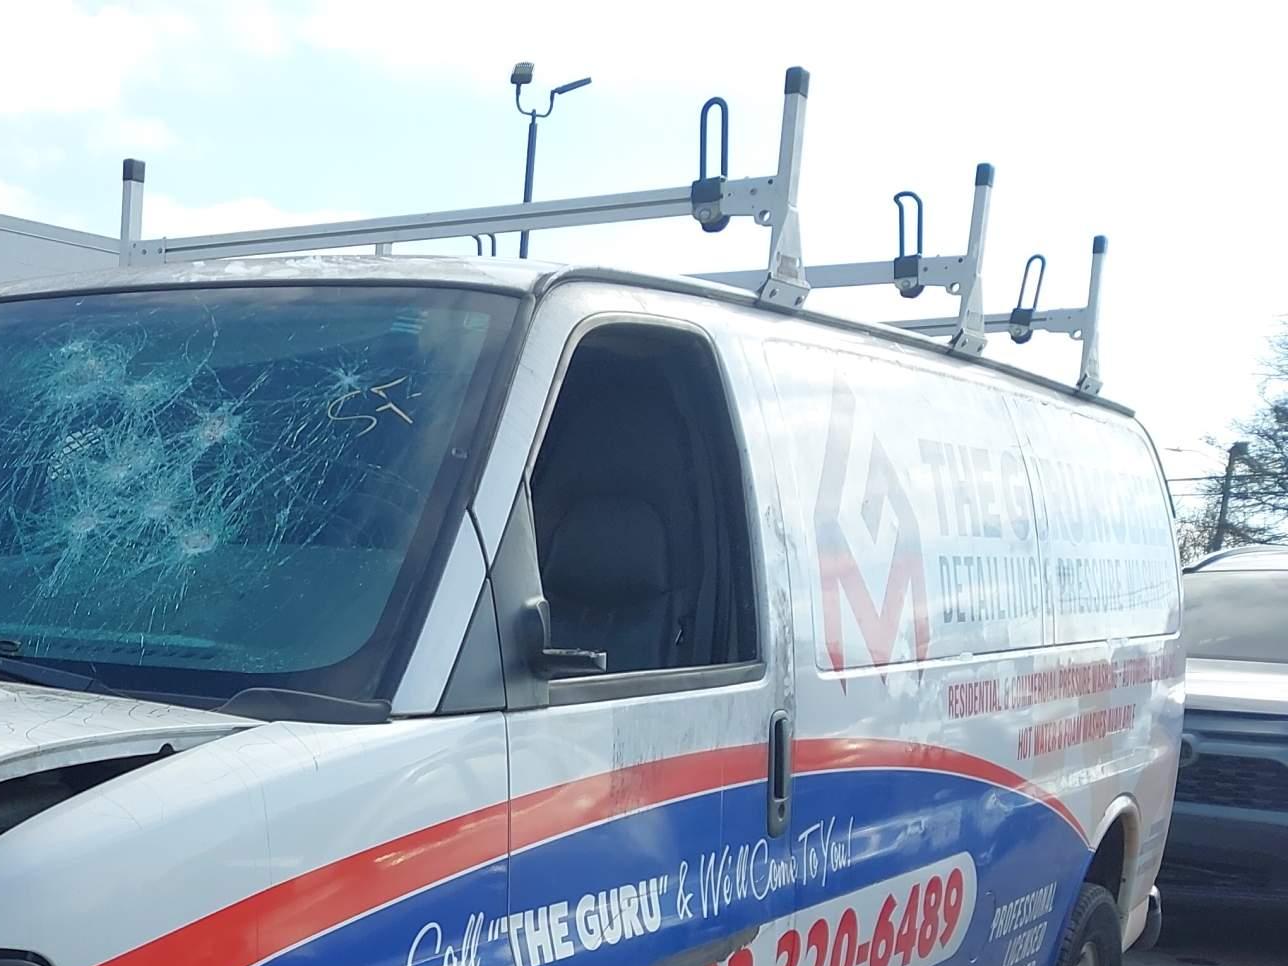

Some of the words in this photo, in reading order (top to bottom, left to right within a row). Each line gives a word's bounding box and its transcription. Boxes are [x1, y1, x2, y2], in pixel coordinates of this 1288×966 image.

[918, 438, 1001, 537] THE
[948, 679, 1002, 720] RESIDENTIAL
[1017, 727, 1032, 760] HOT
[677, 861, 694, 918] &
[749, 838, 799, 901] Come
[798, 825, 820, 886] To
[819, 815, 854, 888] You!
